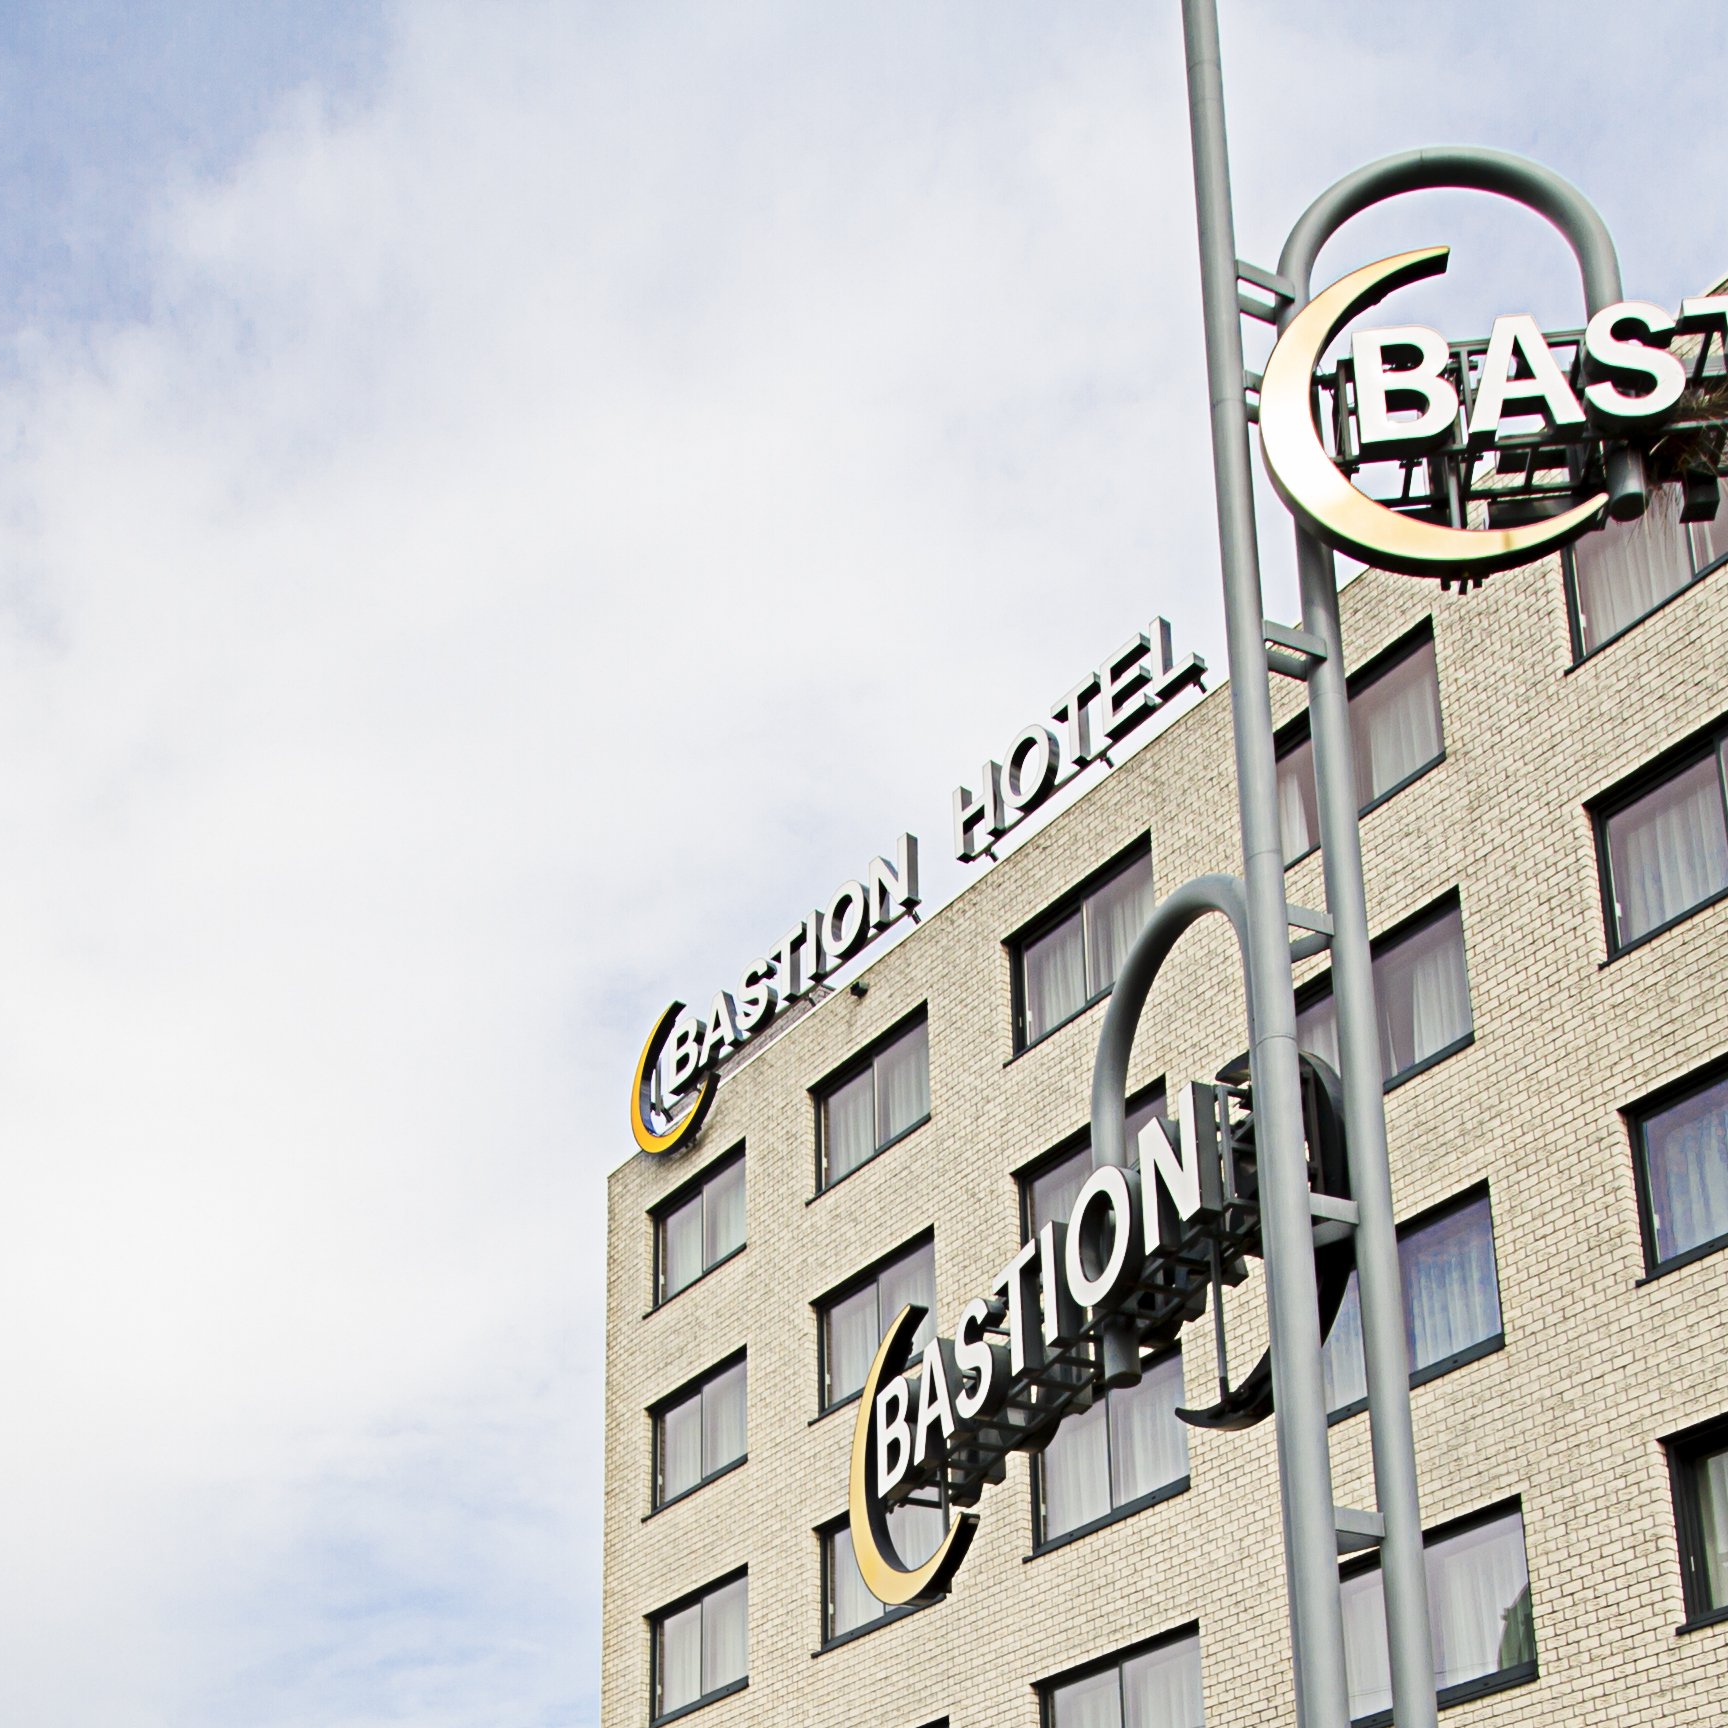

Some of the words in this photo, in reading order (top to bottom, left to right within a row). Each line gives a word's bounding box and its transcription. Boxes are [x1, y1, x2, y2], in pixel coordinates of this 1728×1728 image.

[668, 831, 920, 1096] BASTION
[952, 615, 1208, 864] HOTEL
[875, 1080, 1218, 1499] BASTION
